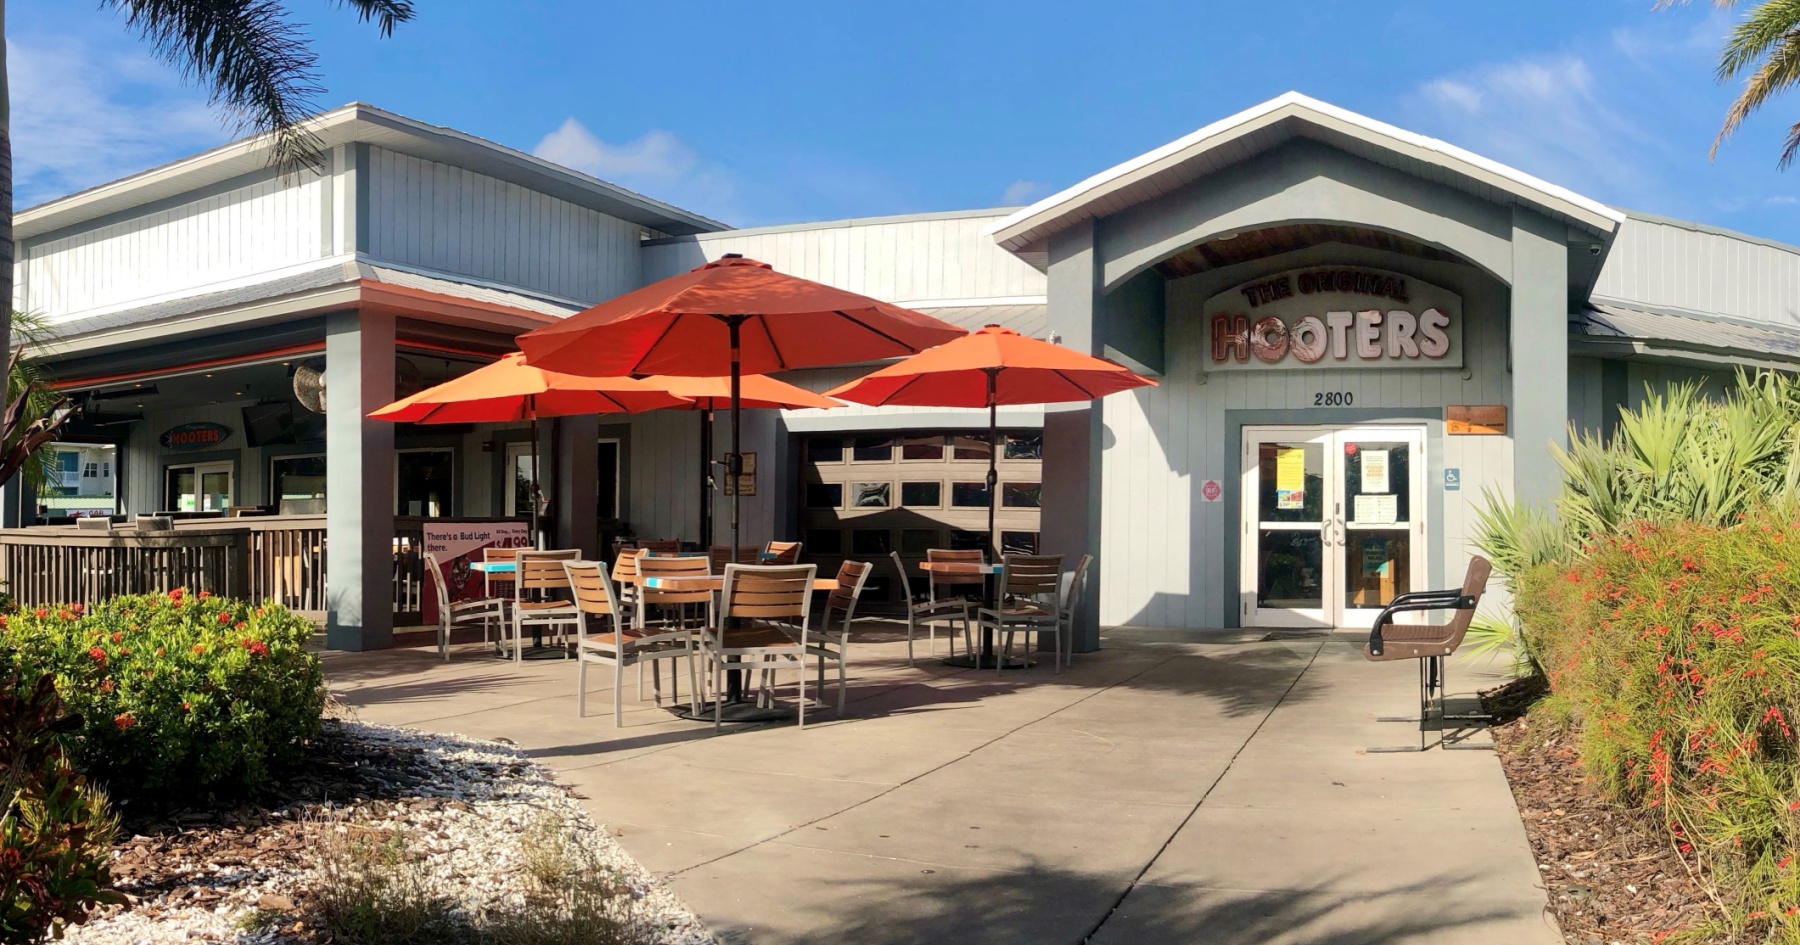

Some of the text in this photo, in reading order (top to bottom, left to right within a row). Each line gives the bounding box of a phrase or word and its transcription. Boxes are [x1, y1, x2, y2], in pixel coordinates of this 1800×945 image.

[1241, 270, 1410, 308] THE ORIGINAL
[1210, 308, 1450, 363] HOOTERS
[1313, 391, 1353, 407] 2800
[172, 429, 219, 445] HOOTERS
[427, 532, 452, 540] There's
[460, 532, 473, 540] Bud
[474, 532, 491, 542] Light
[427, 544, 448, 552] there.
